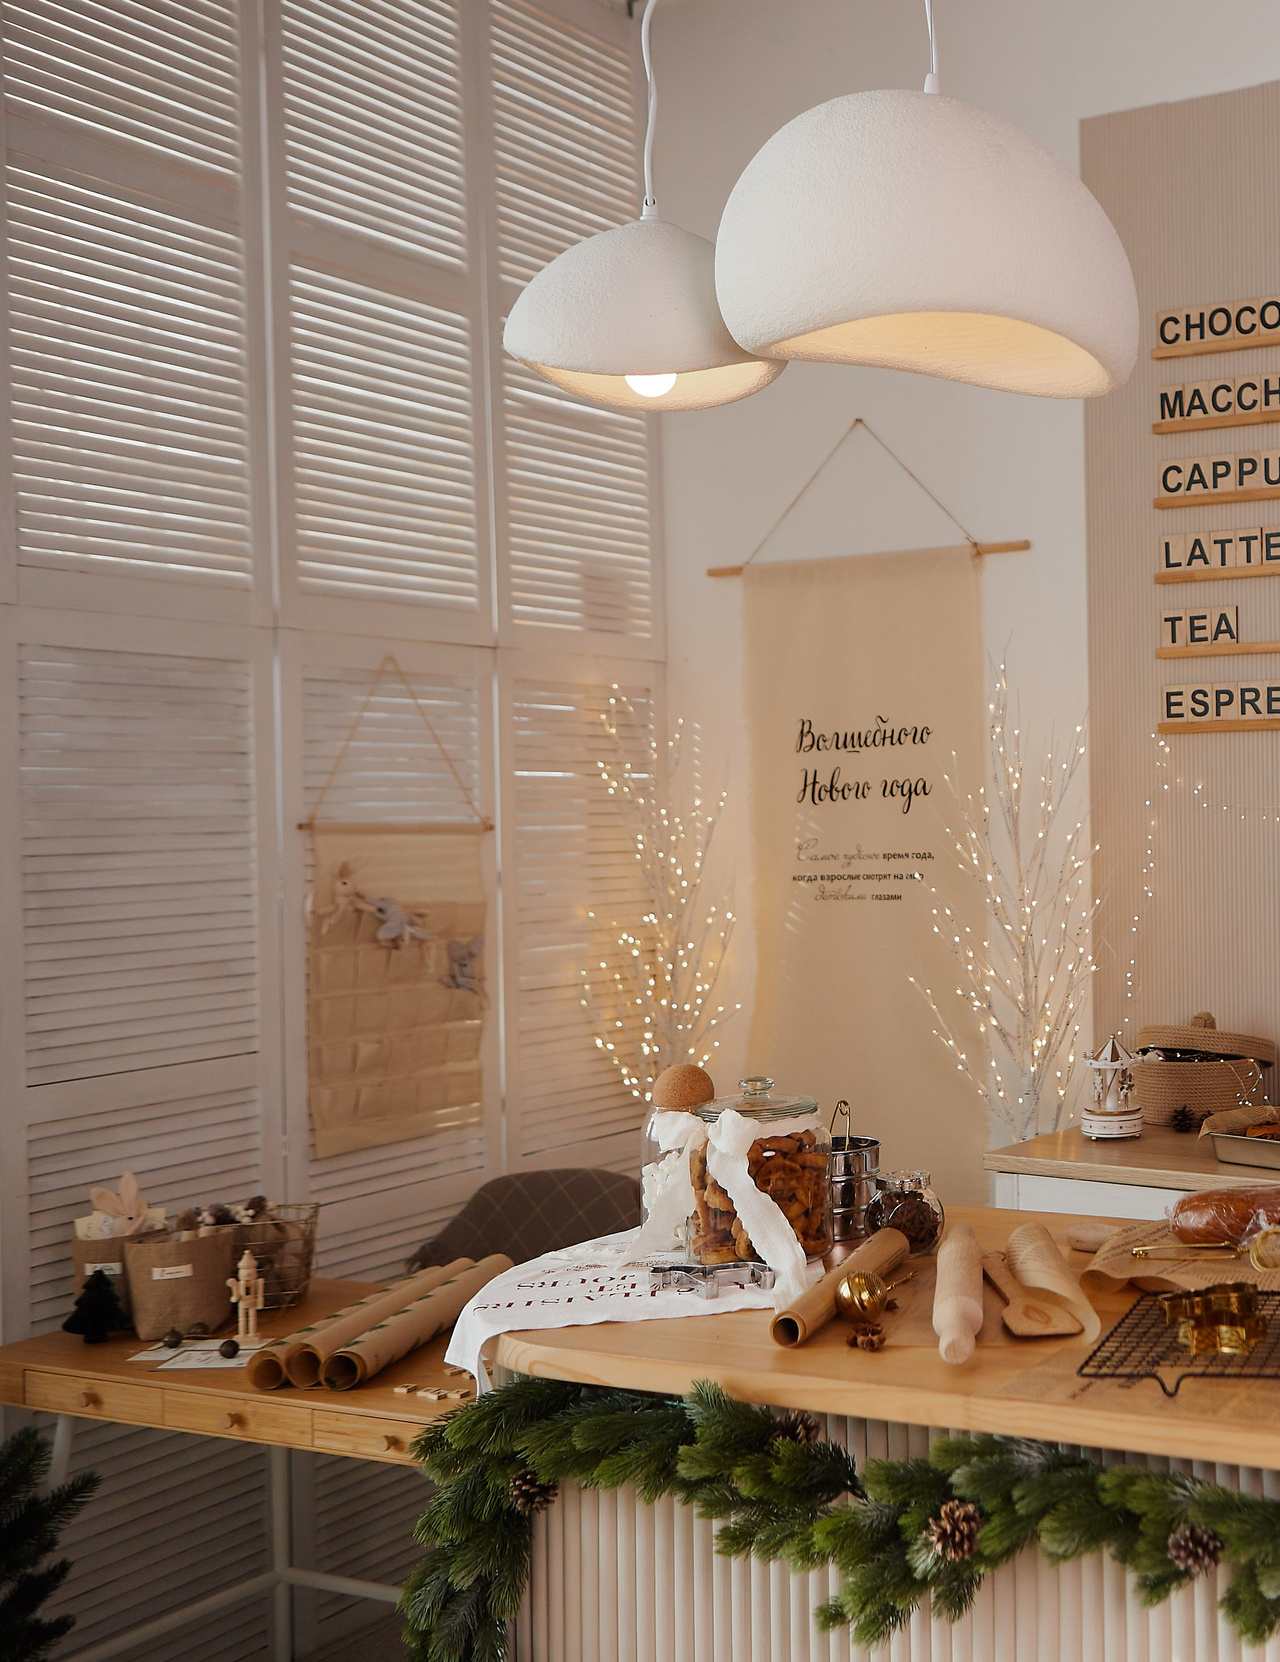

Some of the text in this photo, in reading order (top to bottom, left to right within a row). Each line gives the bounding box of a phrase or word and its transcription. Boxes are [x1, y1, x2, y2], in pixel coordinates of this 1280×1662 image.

[1164, 612, 1237, 644] TEA
[796, 715, 933, 753] Волшебного
[797, 767, 933, 815] Нового года
[882, 851, 909, 862] время
[911, 851, 935, 861] года,
[792, 873, 818, 883] когда
[820, 872, 861, 883] взрослые
[862, 872, 891, 882] смотрят
[893, 873, 904, 881] на
[871, 893, 902, 901] глазами
